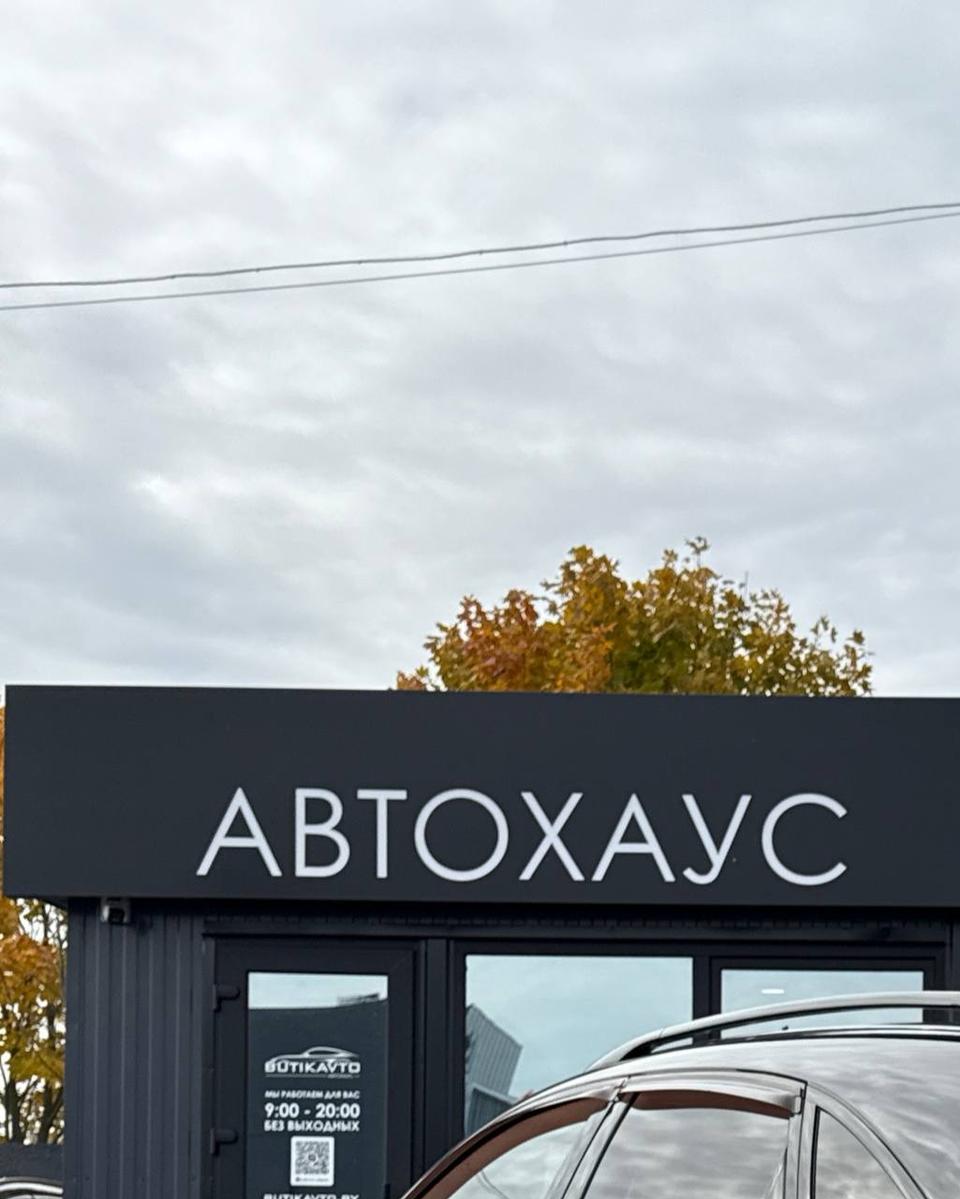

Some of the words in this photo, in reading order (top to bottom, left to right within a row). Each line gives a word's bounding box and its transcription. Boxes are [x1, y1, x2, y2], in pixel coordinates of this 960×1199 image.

[196, 786, 849, 886] АВТОХАУС
[264, 1061, 361, 1073] BUTIKAVTO
[264, 1103, 300, 1118] 9:00
[315, 1103, 361, 1118] 20:00
[264, 1120, 285, 1132] БЕЗ
[287, 1120, 360, 1132] ВЫХОДНЫХ
